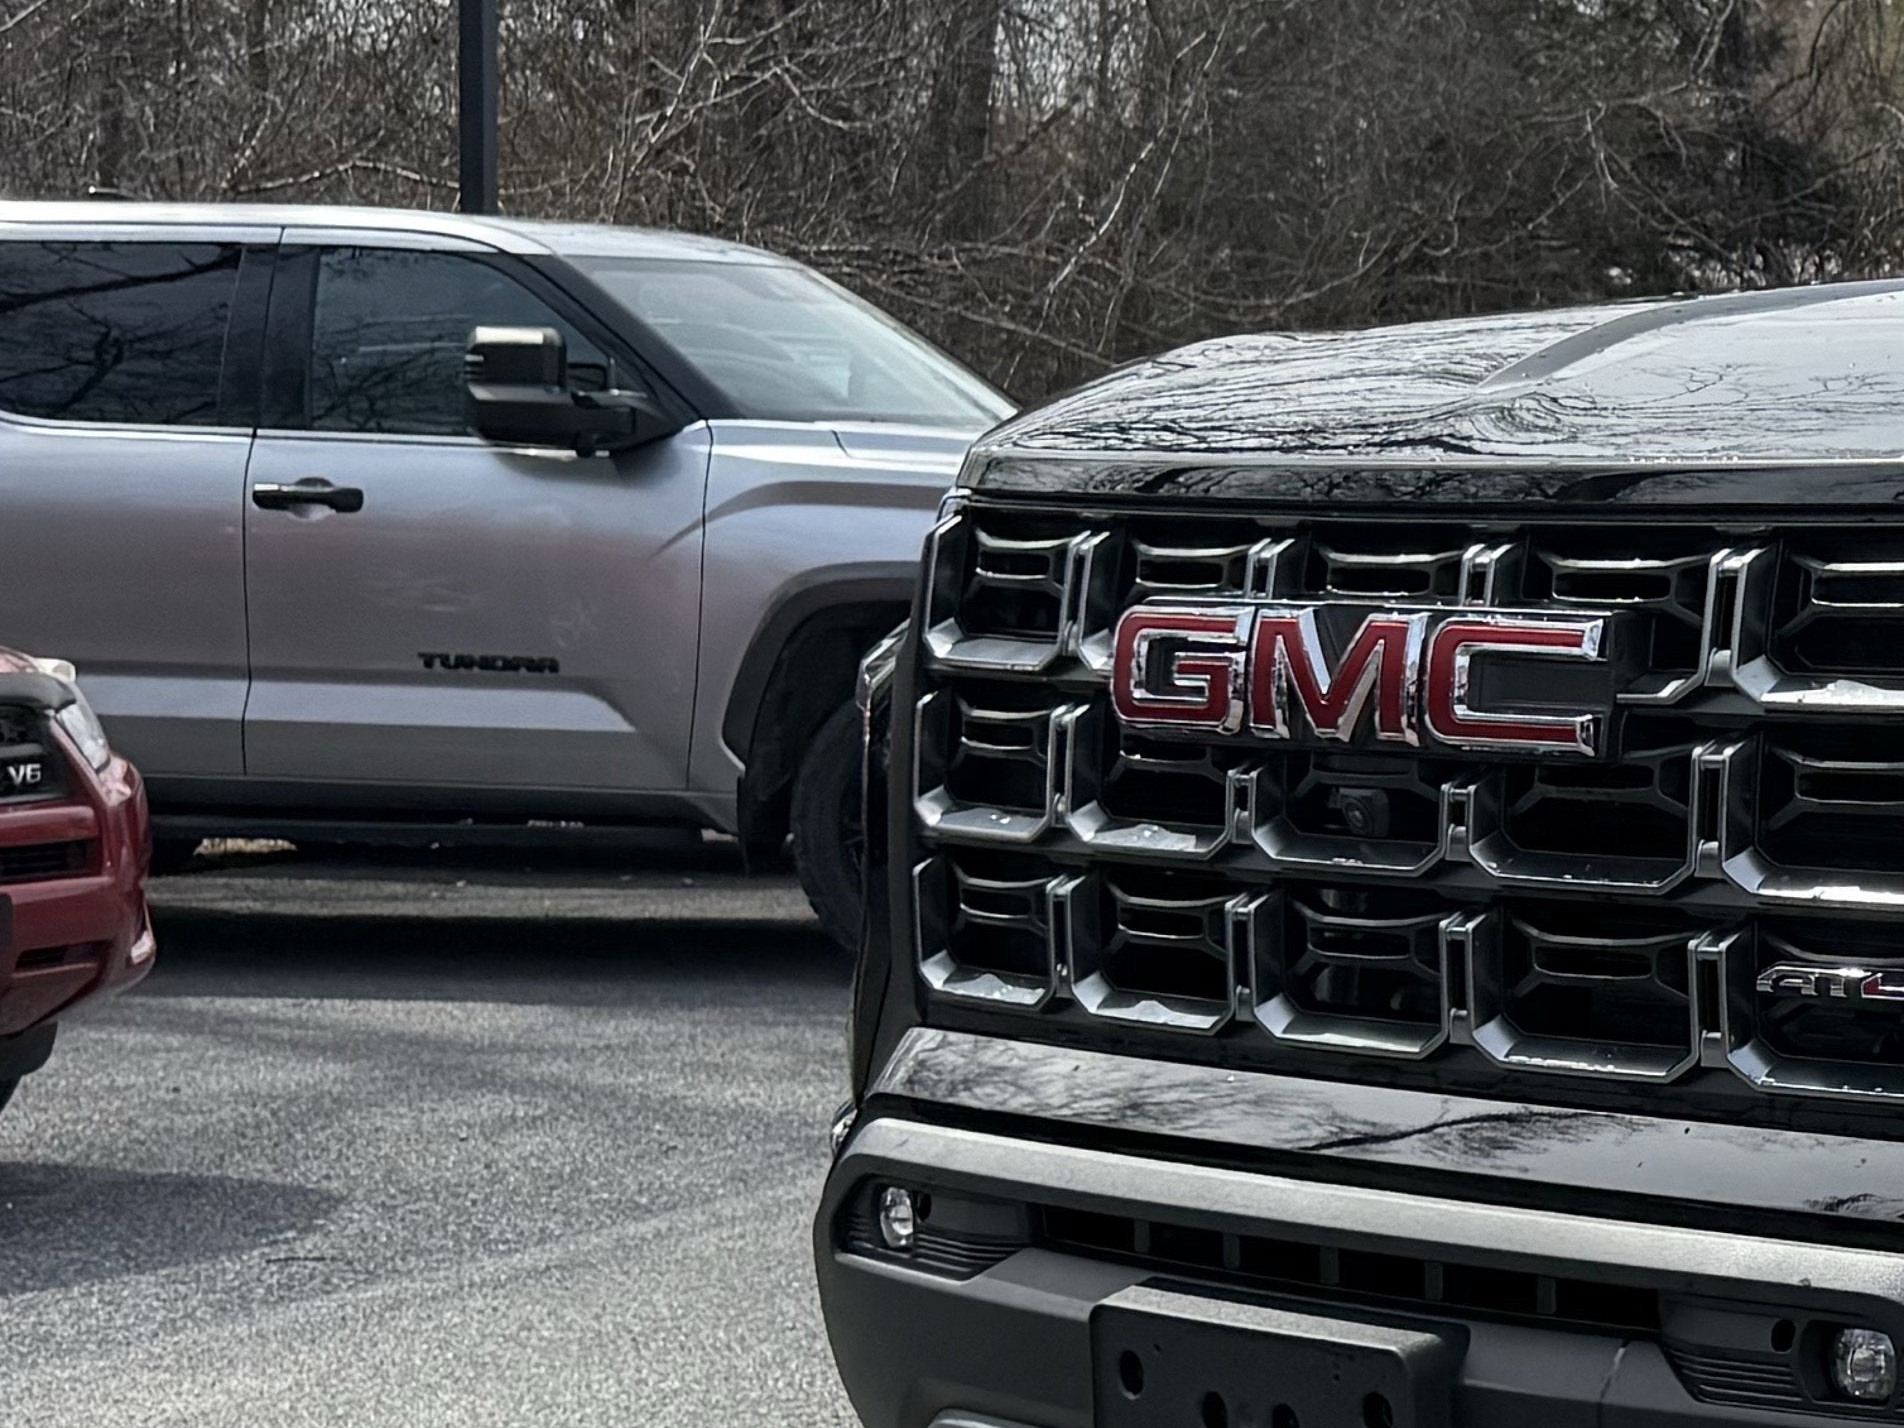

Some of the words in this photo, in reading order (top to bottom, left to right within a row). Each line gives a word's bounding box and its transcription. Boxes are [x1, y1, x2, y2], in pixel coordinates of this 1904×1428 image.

[417, 652, 560, 674] TUNDRA
[1111, 605, 1604, 757] GMC
[7, 763, 42, 785] V6
